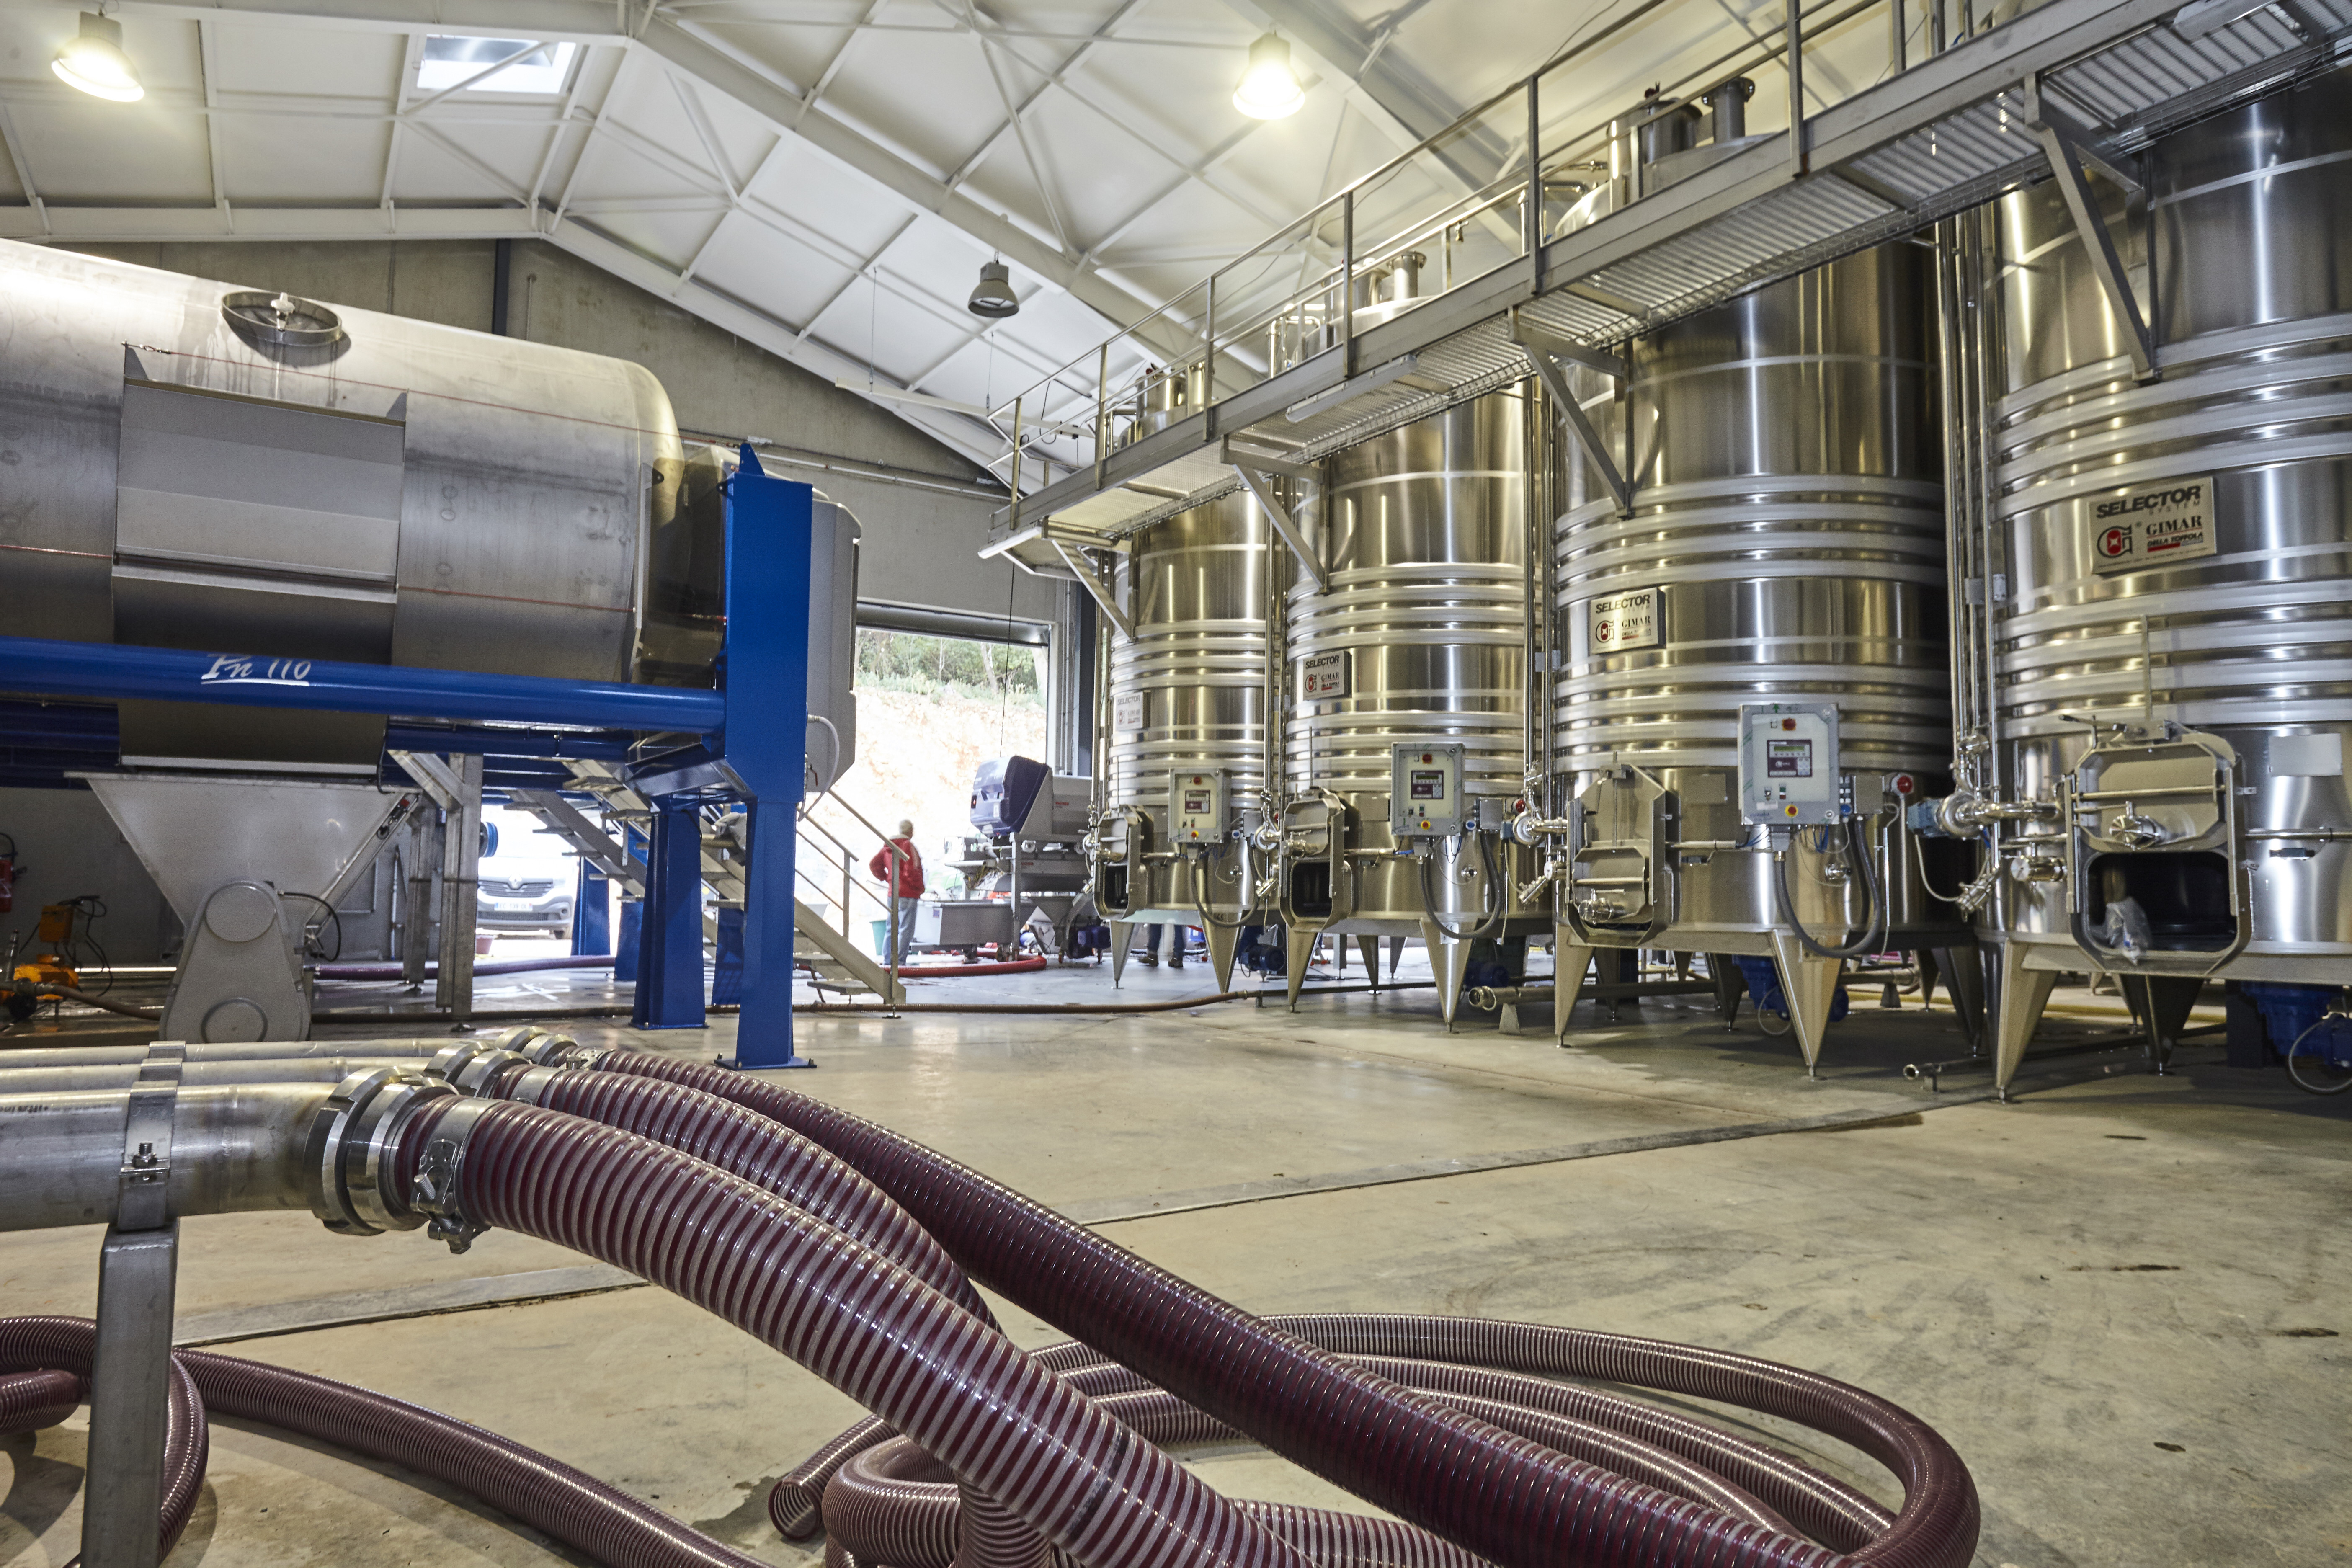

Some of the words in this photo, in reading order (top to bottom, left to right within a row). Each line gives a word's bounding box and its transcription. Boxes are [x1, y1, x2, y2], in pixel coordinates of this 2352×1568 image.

[2096, 485, 2201, 519] SELECTOR
[2148, 500, 2200, 516] SYSTEM
[2146, 515, 2202, 535] GIMAR
[1596, 594, 1651, 614] SELECTOR
[1622, 615, 1651, 628] GIMAR
[1305, 655, 1339, 669] SELECTOR
[1321, 672, 1339, 681] GIMAR
[1118, 695, 1140, 705] SELECTOR
